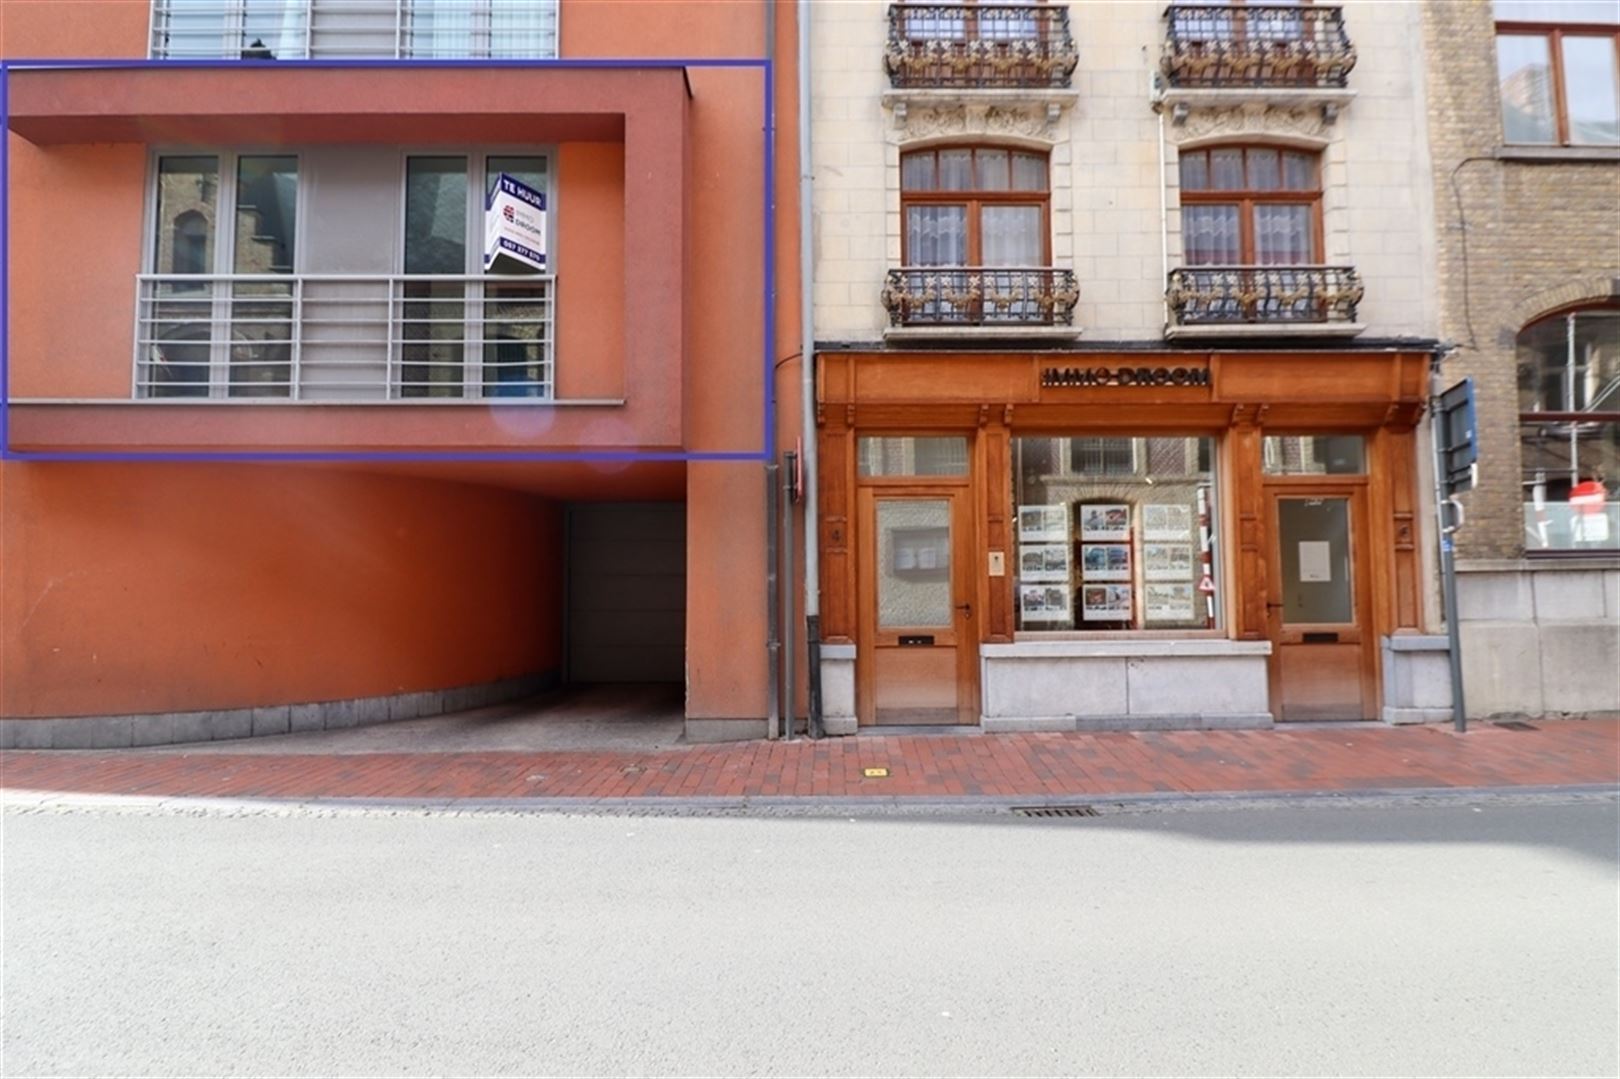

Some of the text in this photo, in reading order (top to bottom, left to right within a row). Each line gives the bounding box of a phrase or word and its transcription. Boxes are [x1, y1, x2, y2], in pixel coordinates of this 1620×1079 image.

[503, 179, 541, 205] TE HUUR
[515, 219, 541, 235] DROOM
